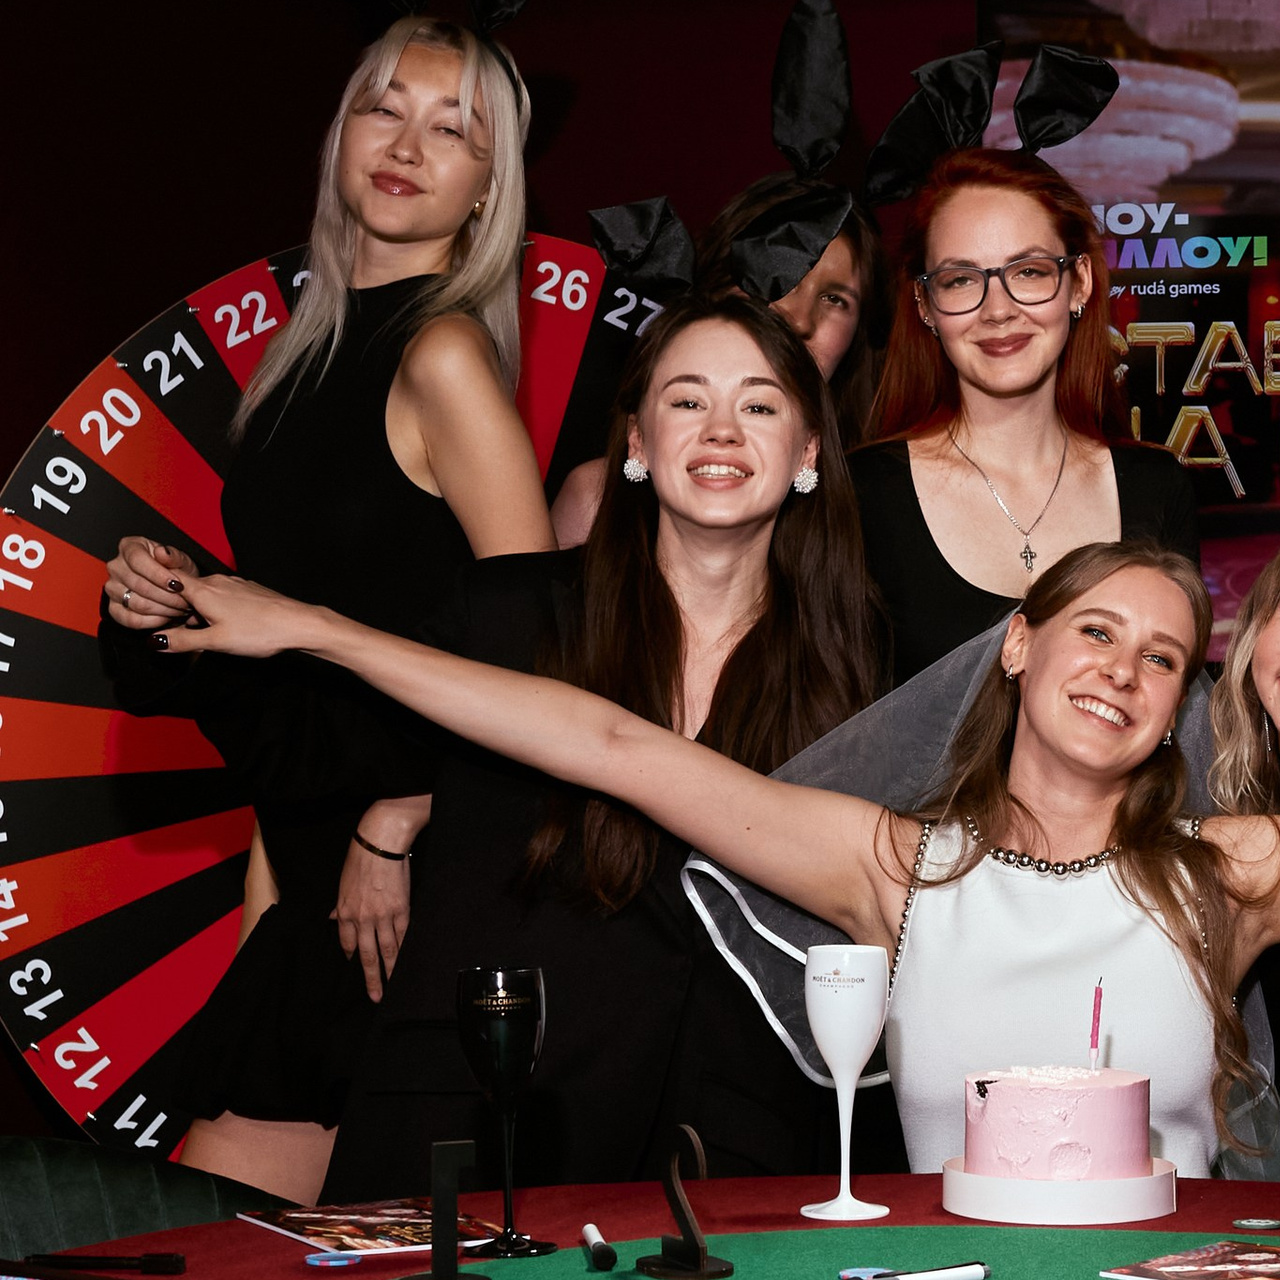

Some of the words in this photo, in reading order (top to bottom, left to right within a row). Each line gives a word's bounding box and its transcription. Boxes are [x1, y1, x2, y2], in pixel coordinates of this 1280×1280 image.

[531, 261, 590, 311] 26
[603, 287, 664, 337] 27
[1131, 279, 1166, 295] rudá
[1169, 284, 1221, 299] games
[215, 291, 278, 348] 22
[142, 331, 204, 396] 21
[79, 387, 141, 456] 20
[31, 456, 86, 515] 19
[0, 533, 45, 591] 18
[9, 959, 64, 1020] 13
[54, 1027, 111, 1090] 12
[113, 1093, 168, 1148] 11
